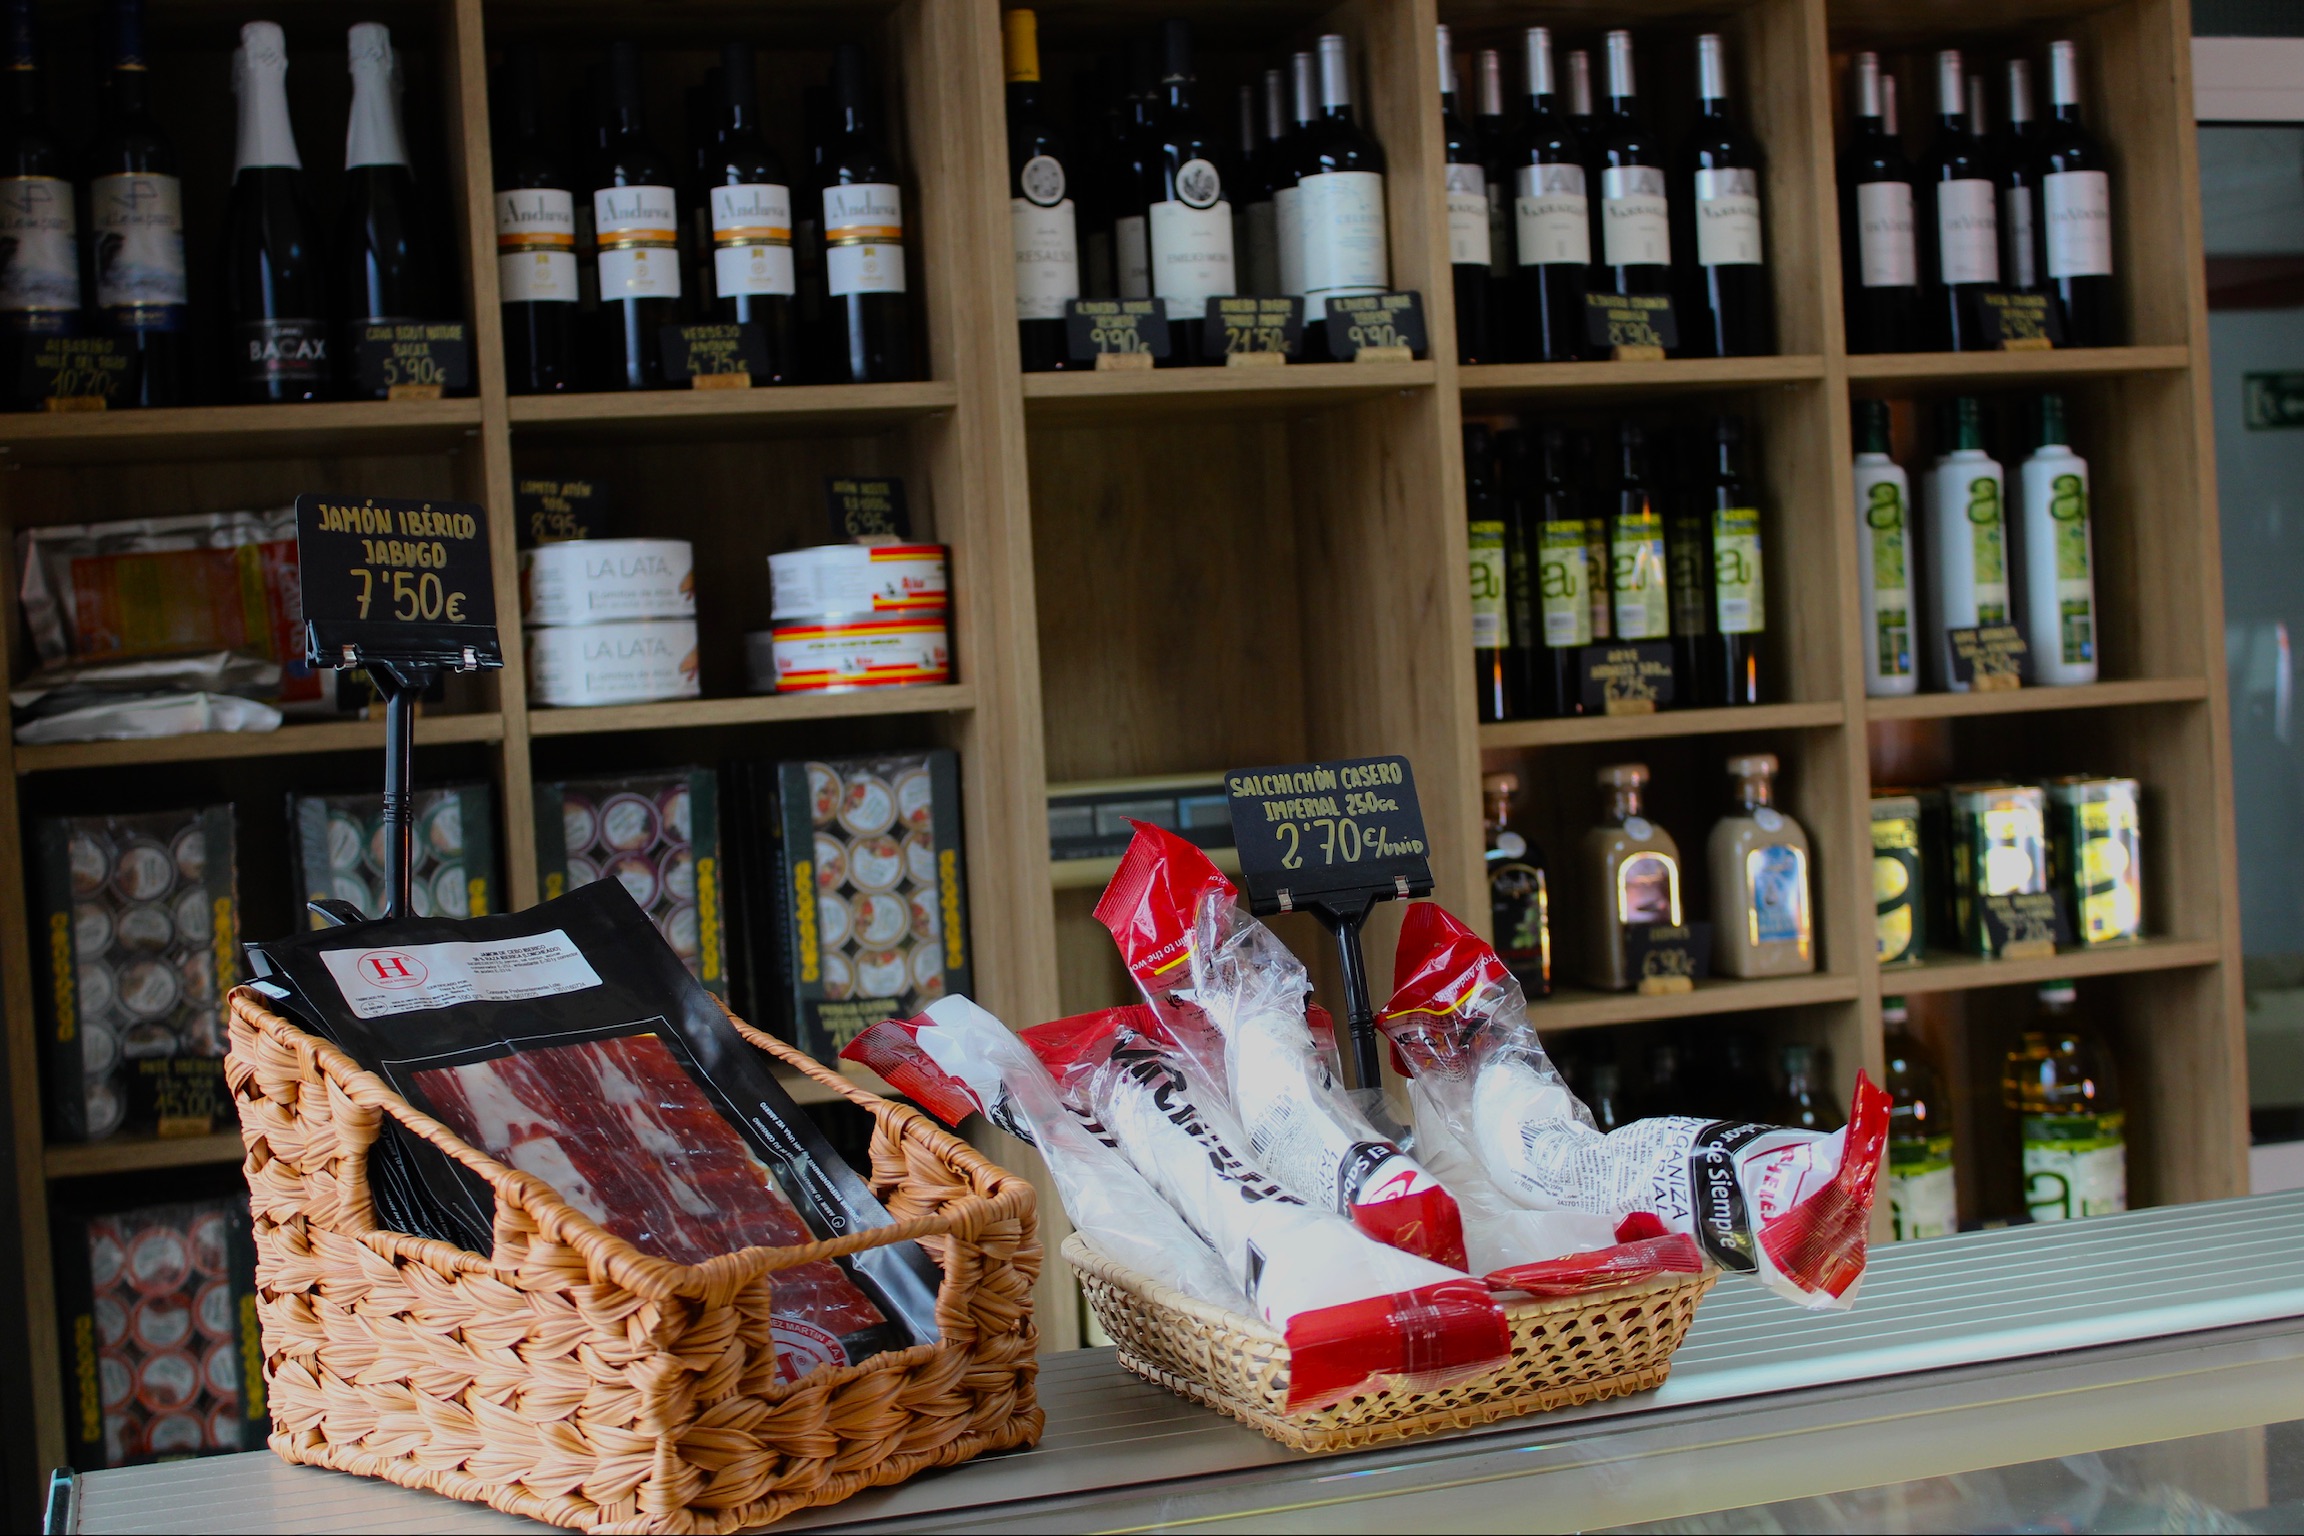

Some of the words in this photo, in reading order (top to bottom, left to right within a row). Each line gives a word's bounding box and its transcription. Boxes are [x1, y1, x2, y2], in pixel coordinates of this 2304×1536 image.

[249, 338, 328, 362] BACAX
[383, 357, 446, 385] 5'90€
[318, 498, 393, 535] JAMÓN
[398, 503, 477, 540] IBÉRICO
[361, 539, 447, 569] JABUGO
[350, 568, 467, 623] 7'50€
[1229, 764, 1336, 797] SALCHICHÓN
[1340, 762, 1403, 791] CASERO
[1262, 796, 1341, 822] IMPERIAL
[1146, 949, 1164, 964] the
[1162, 943, 1175, 955] to
[367, 957, 414, 980] H
[1473, 951, 1498, 973] From
[758, 1100, 778, 1121] ABIERTO
[751, 1115, 775, 1143] CONSUMO
[774, 1118, 785, 1130] VEZ
[782, 1126, 796, 1143] UNA
[772, 1139, 782, 1150] SU
[1365, 1144, 1390, 1160] El
[1706, 1141, 1723, 1164] de
[814, 1192, 823, 1202] 10
[1708, 1164, 1737, 1249] Siempre
[787, 1322, 823, 1341] MARTIN
